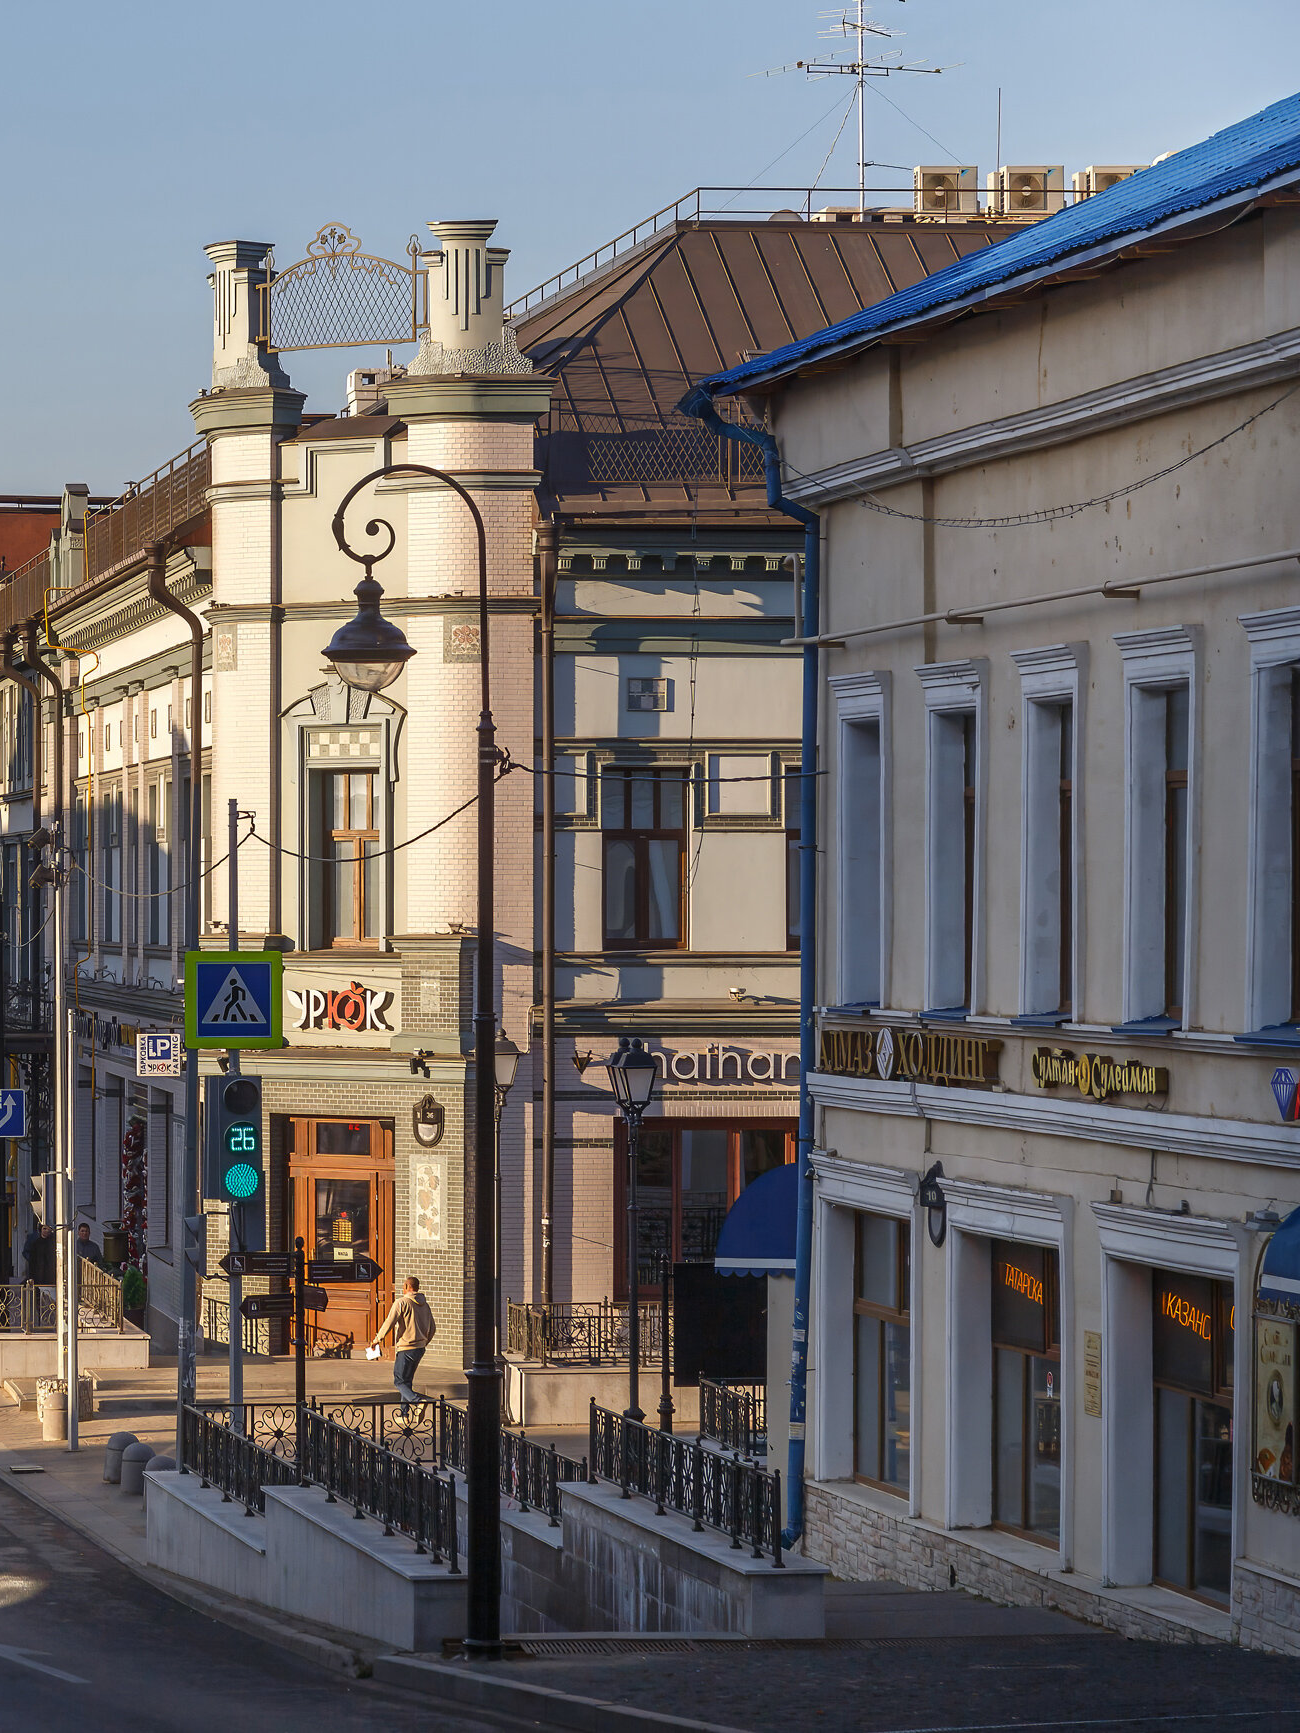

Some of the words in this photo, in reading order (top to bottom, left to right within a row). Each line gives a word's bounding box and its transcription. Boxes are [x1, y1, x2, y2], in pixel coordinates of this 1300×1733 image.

[286, 981, 387, 1031] УРЮК
[820, 1030, 873, 1074] АЛМАЗ
[896, 1032, 989, 1087] ХОЛДИНГ
[1032, 1047, 1074, 1088] Султан
[1091, 1055, 1156, 1099] Сулейман
[231, 1127, 255, 1151] 26
[926, 1190, 937, 1201] 10
[1166, 1292, 1211, 1341] КАЗАНС
